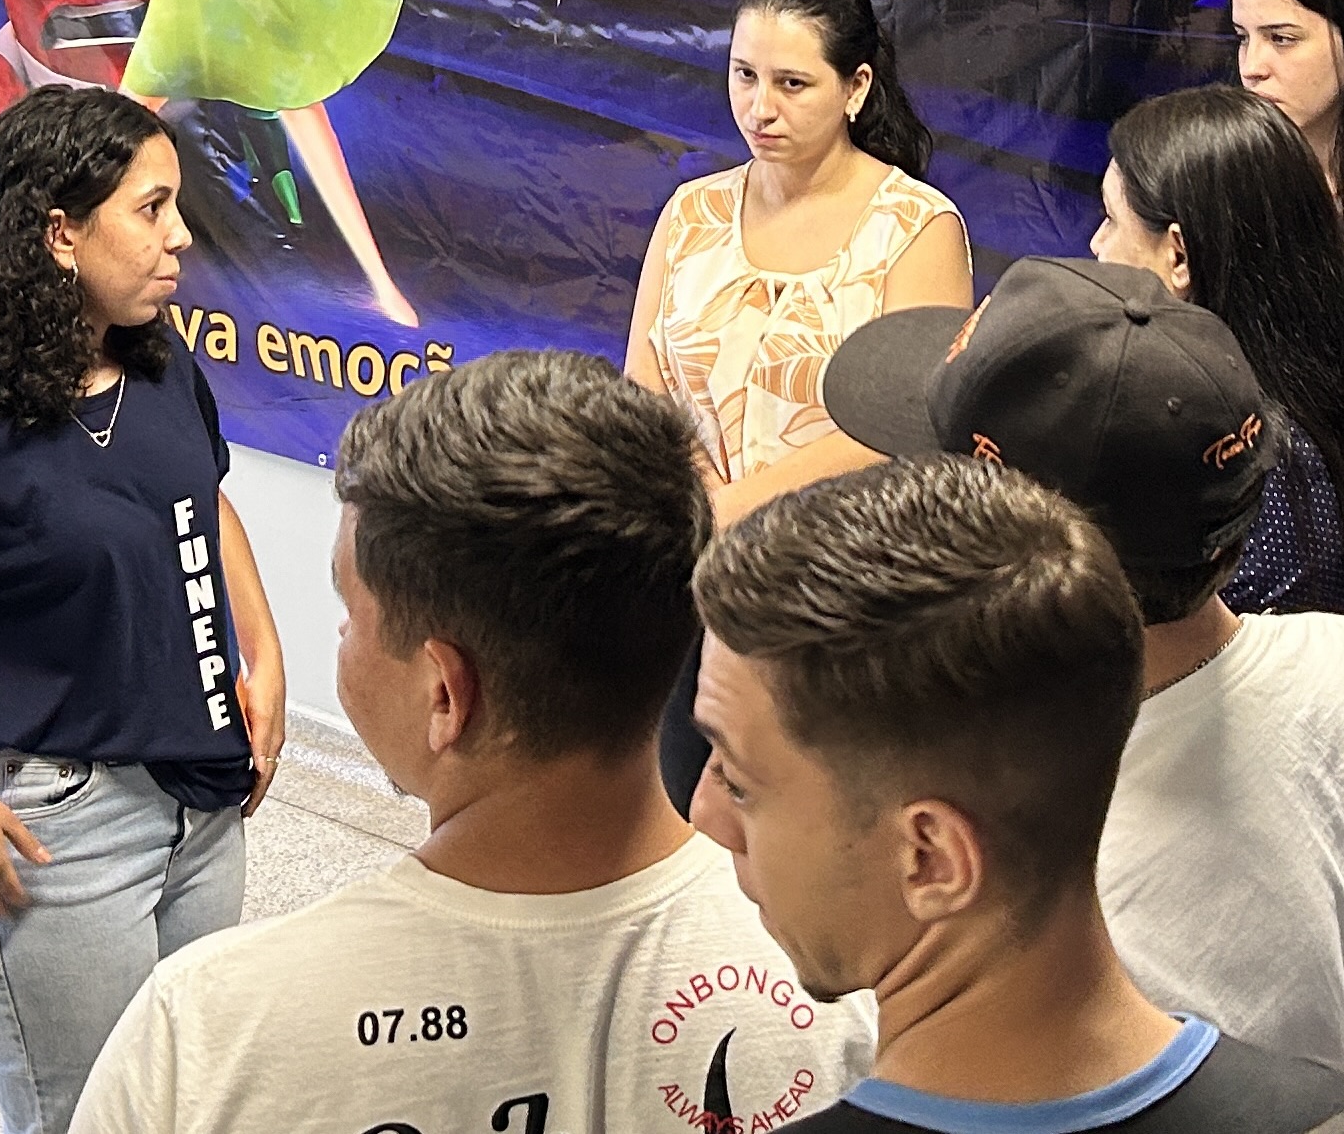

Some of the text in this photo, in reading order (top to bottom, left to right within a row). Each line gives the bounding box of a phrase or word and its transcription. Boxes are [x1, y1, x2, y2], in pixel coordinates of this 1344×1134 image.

[172, 496, 231, 732] FUNEPE
[357, 1004, 469, 1046] 07.88
[651, 964, 815, 1045] ONBONGO
[750, 1068, 815, 1134] AHEAD
